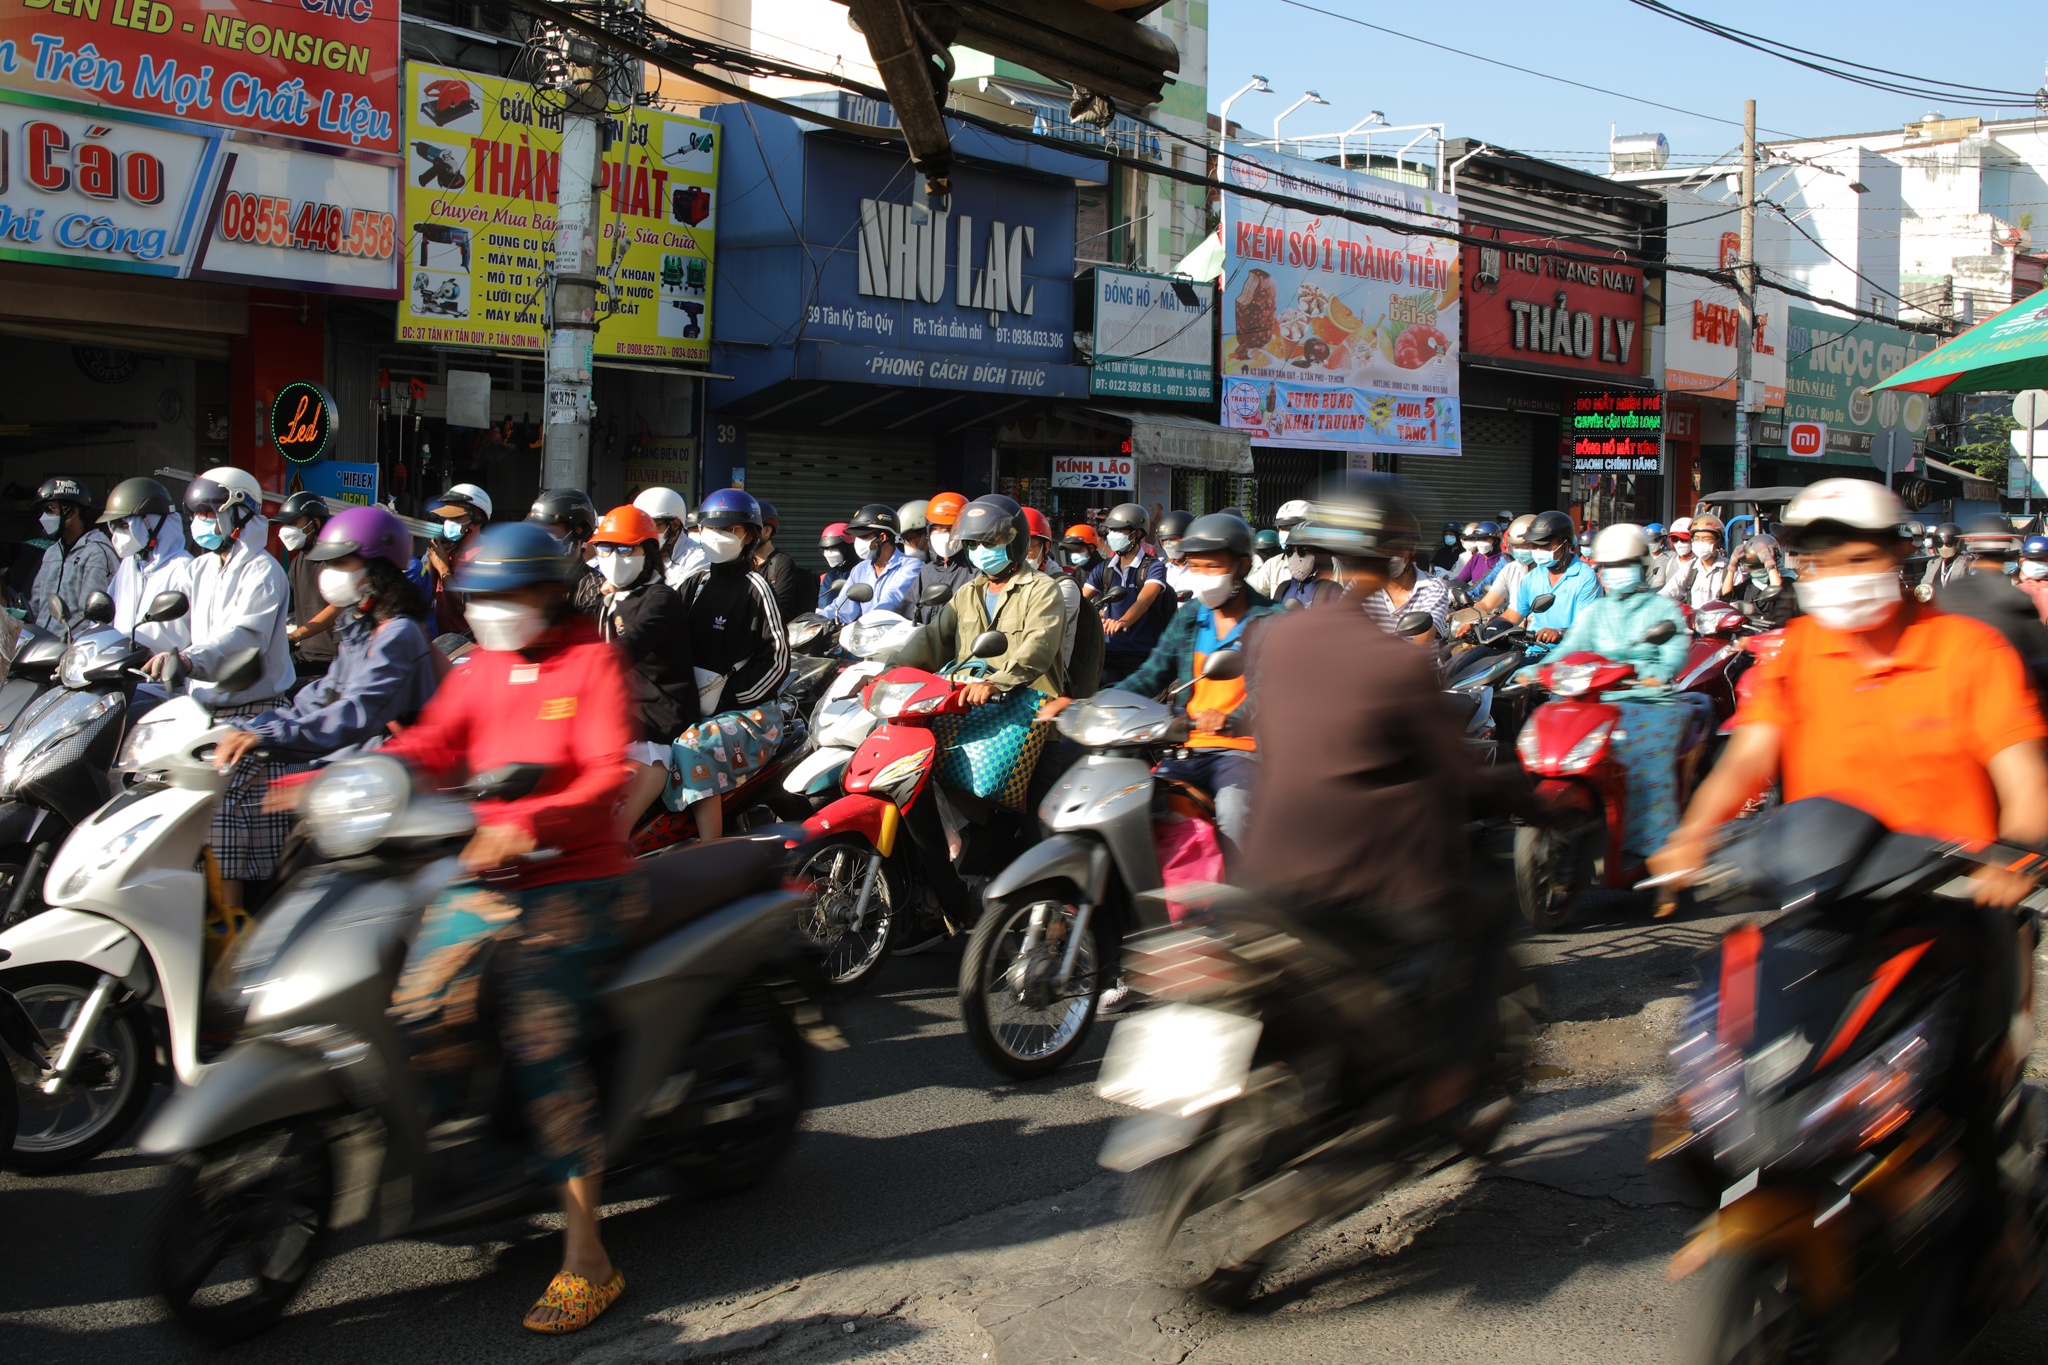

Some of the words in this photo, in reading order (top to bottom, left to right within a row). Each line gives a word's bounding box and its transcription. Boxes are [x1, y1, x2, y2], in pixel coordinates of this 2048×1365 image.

[110, 0, 175, 35] LED
[202, 13, 371, 77] NEONSIGN
[31, 32, 125, 94] Trên
[132, 54, 214, 115] Mọi
[221, 71, 312, 127] Chất
[318, 88, 393, 145] Liệu
[21, 119, 166, 207] Cáo
[470, 133, 561, 205] THÀN
[221, 190, 397, 261] 0855.448.558
[430, 198, 489, 223] Chuyên
[493, 206, 528, 229] Mua
[53, 212, 168, 261] Công
[488, 233, 520, 250] DỤNG
[523, 238, 539, 254] CỤ
[634, 226, 660, 246] Sửa
[663, 231, 697, 251] Chữa
[488, 251, 514, 267] MÁY
[1235, 220, 1285, 265] KEM
[1288, 217, 1321, 269] SỐ
[1321, 237, 1335, 273] 1
[1337, 234, 1404, 285] TRÀNG
[1406, 241, 1449, 292] TIỀN
[487, 270, 506, 284] MÔ
[508, 273, 523, 286] TƠ
[621, 268, 656, 283] KHOAN
[956, 213, 1035, 329] LẠC
[486, 289, 511, 303] LƯỠI
[627, 284, 655, 299] NƯỚC
[1104, 277, 1133, 306] ĐỒNG
[1136, 280, 1151, 308] HỒ
[485, 307, 511, 322] MÁY
[822, 305, 841, 327] Tân
[856, 310, 874, 330] Tân
[402, 326, 415, 340] ĐC:
[416, 327, 426, 340] 37
[428, 325, 443, 342] TÂN
[455, 327, 469, 344] TÂN
[488, 332, 495, 345] P.
[496, 330, 510, 346] TÂN
[511, 332, 526, 348] SƠN
[913, 317, 927, 335] Fb:
[928, 315, 948, 337] Trần
[949, 317, 968, 340] đình
[969, 324, 983, 341] nhi
[996, 327, 1011, 345] ĐT:
[1011, 329, 1064, 349] 0936.033.306
[1508, 289, 1596, 360] THẢO
[1599, 315, 1636, 365] LY
[616, 342, 627, 354] ĐT:
[1809, 328, 1875, 387] NGỌC
[929, 358, 967, 382] CÁCH
[972, 361, 1006, 385] ĐÍCH
[1010, 367, 1046, 391] THỰC
[1111, 361, 1121, 374] TÂN
[1129, 361, 1139, 375] TÂN
[1157, 364, 1167, 377] TÂN
[1193, 367, 1202, 381] TÂN
[1095, 378, 1107, 390] ĐT:
[1108, 379, 1127, 391] 0122
[1127, 381, 1141, 392] 592
[1142, 383, 1152, 393] 85
[1152, 384, 1162, 394] 81
[1166, 384, 1183, 396] 0971
[1185, 386, 1198, 397] 150
[1198, 387, 1211, 398] 605
[1230, 395, 1260, 404] TRANTICO
[278, 394, 323, 444] Led
[1396, 402, 1421, 419] MUA
[1423, 396, 1436, 420] 5
[716, 424, 737, 444] 39
[1396, 421, 1427, 445] TẶNG
[1429, 417, 1438, 443] 1
[662, 467, 690, 484] PHÁT
[1055, 457, 1094, 474] KÍNH
[1099, 457, 1132, 476] LÃO
[1574, 458, 1604, 470] XIAOMI
[1604, 456, 1631, 470] CHÍNH
[1632, 456, 1658, 471] HÃNG
[342, 470, 375, 489] HIFLEX
